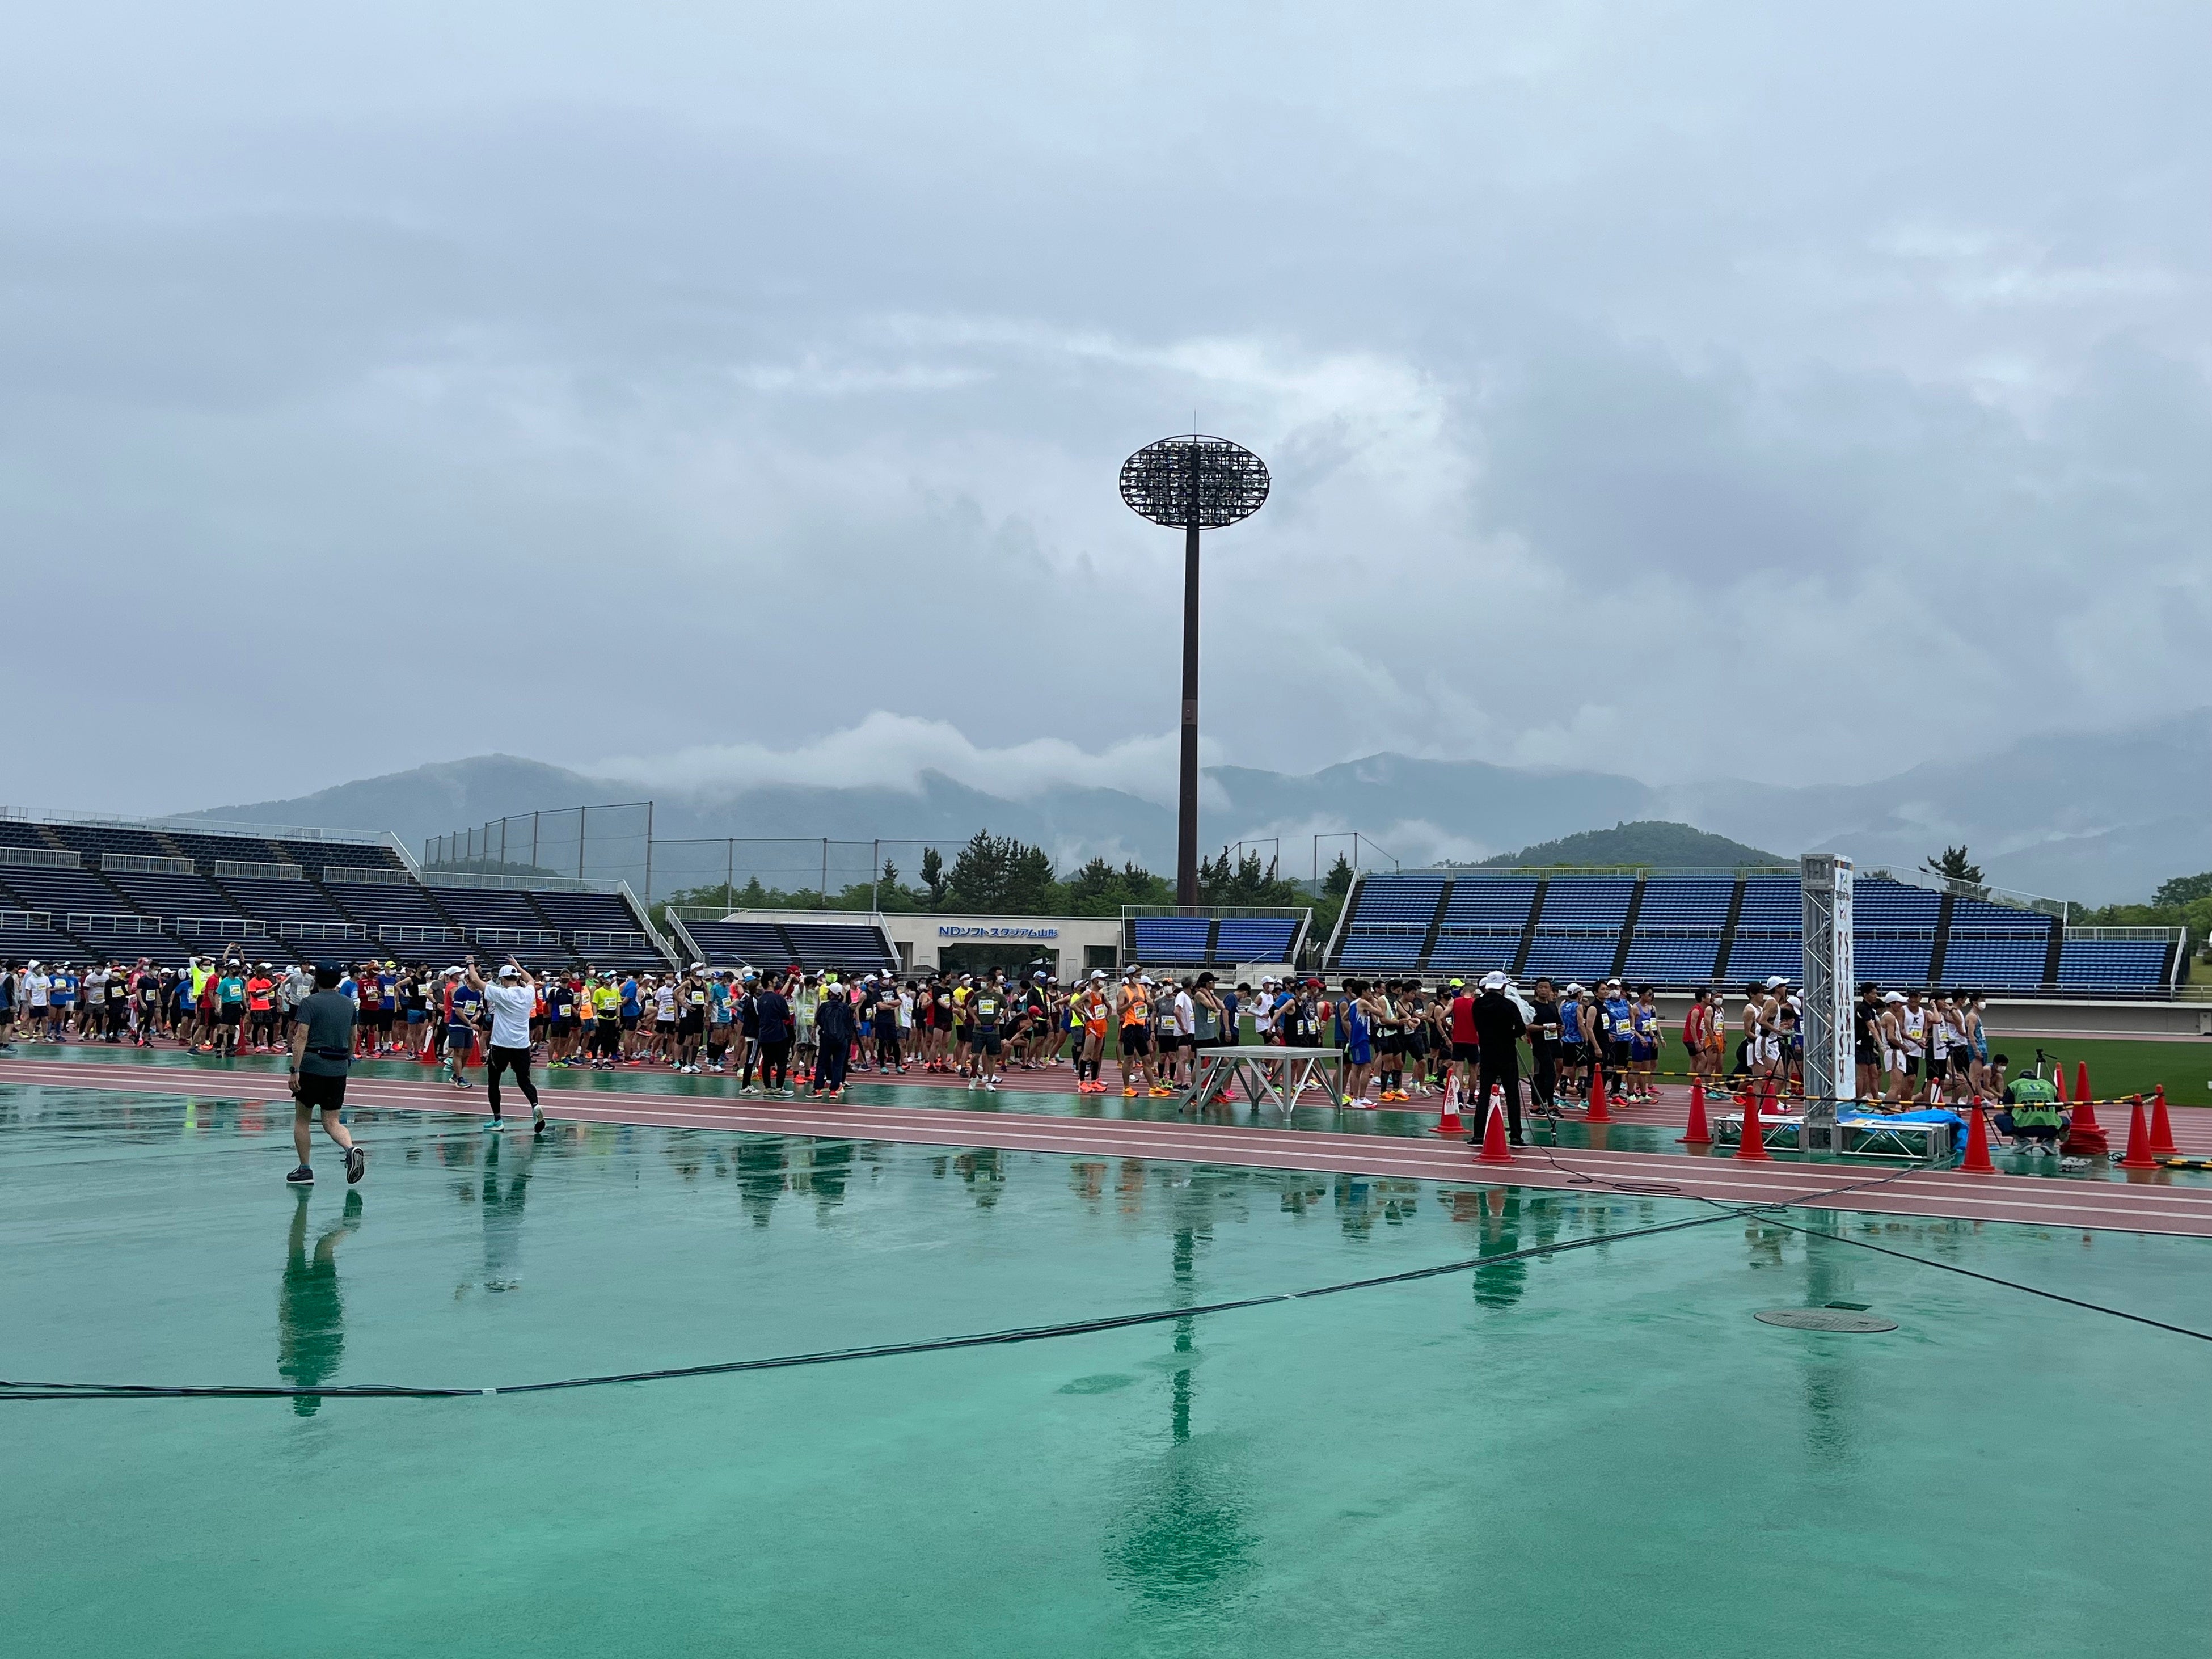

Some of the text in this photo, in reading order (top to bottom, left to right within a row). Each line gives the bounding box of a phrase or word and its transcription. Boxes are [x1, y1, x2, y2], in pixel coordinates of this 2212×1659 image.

[939, 926, 1058, 938] NDソフトスタジアム山形
